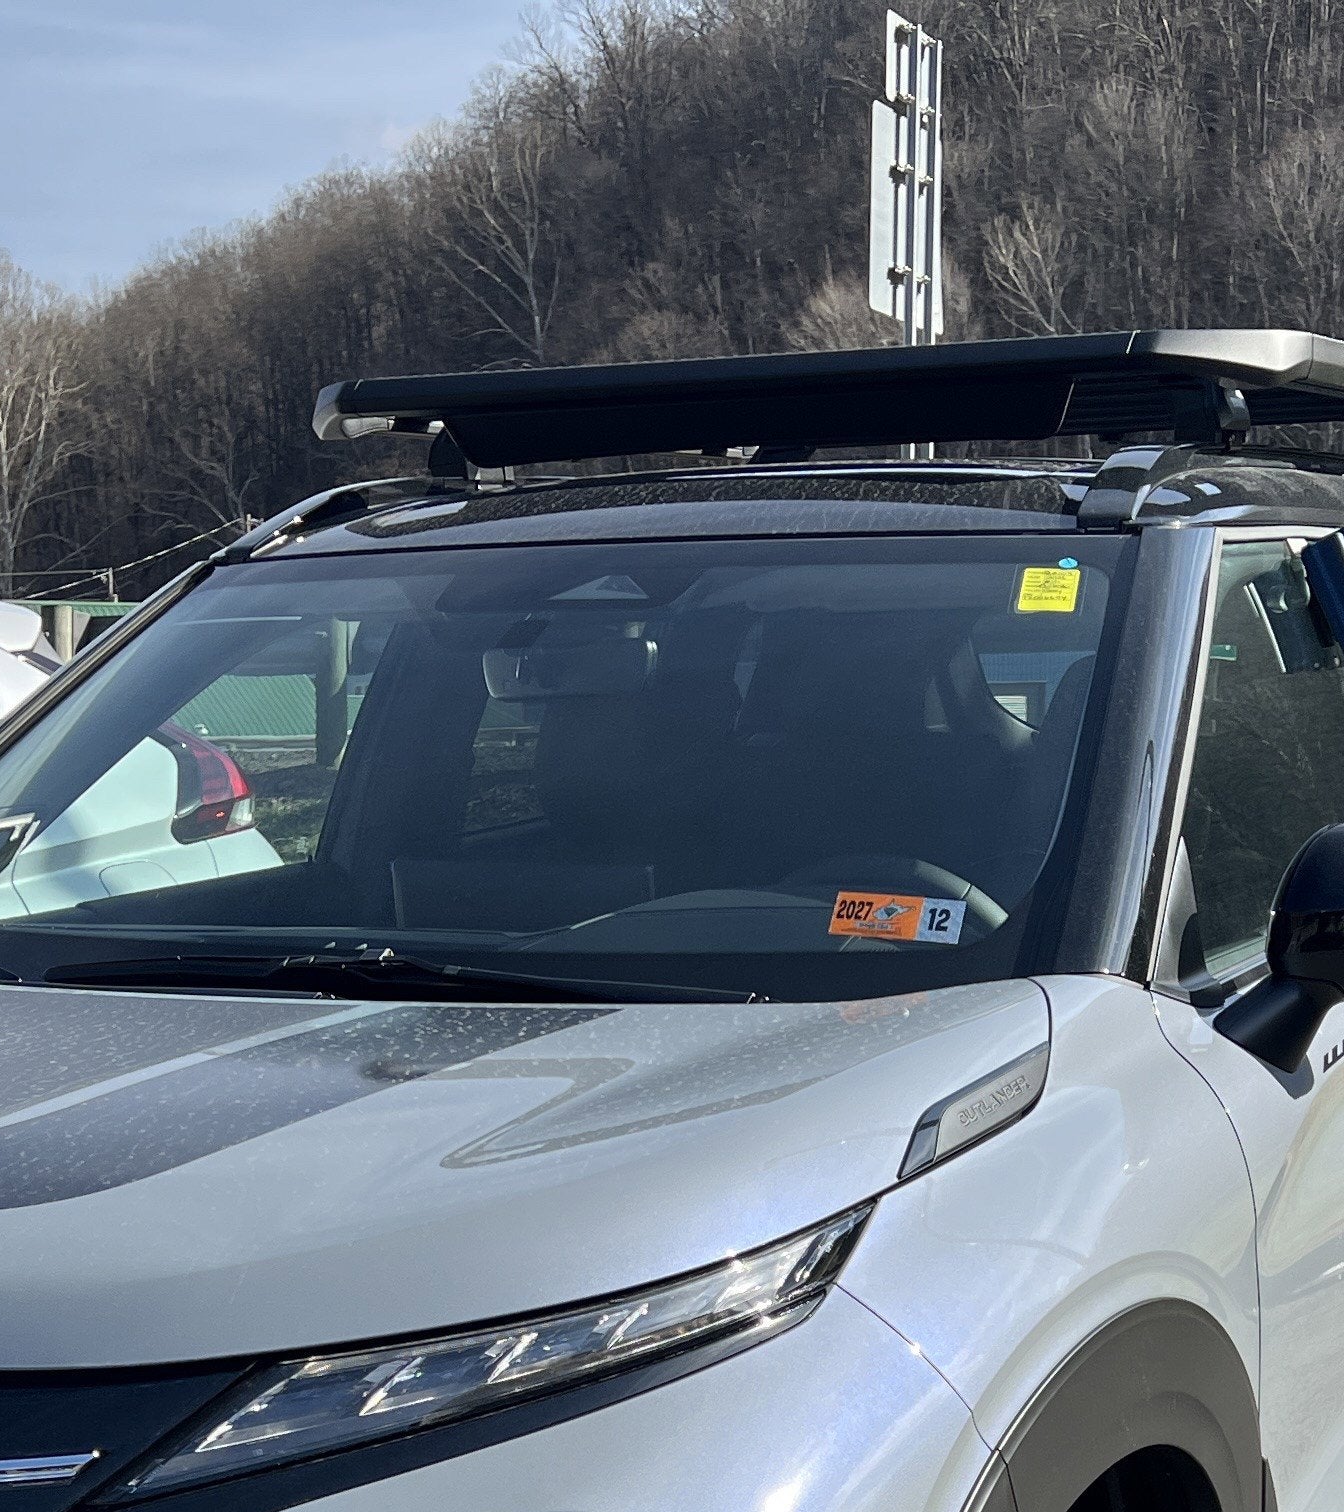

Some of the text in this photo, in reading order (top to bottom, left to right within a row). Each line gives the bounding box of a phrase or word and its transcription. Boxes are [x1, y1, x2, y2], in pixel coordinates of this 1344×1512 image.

[836, 899, 874, 921] 2027
[928, 907, 951, 932] 12
[957, 1075, 1030, 1127] OUTLANDER
